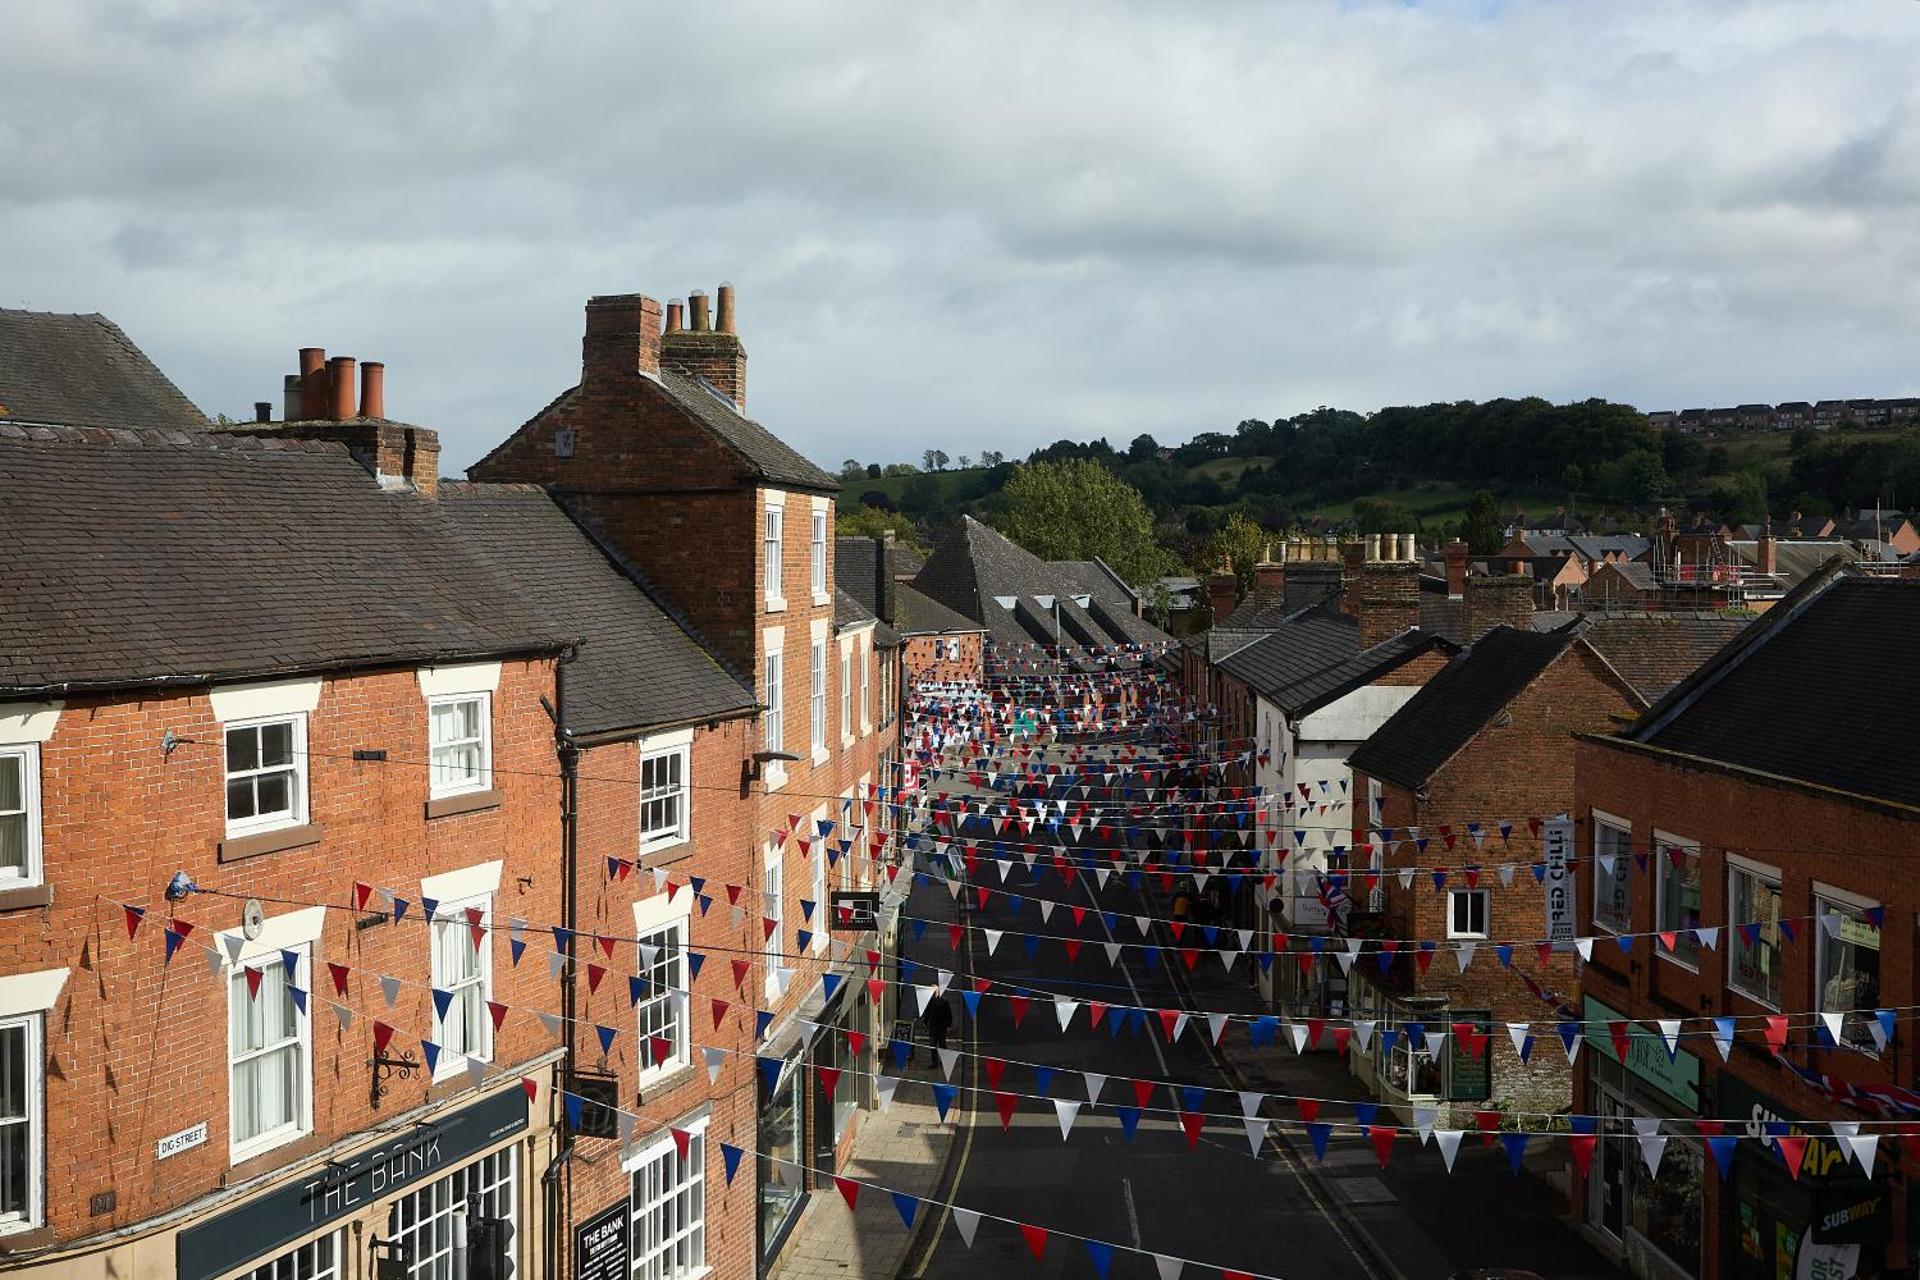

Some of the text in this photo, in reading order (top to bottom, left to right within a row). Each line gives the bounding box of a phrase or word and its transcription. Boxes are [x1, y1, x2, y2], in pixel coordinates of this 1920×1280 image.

[1550, 887, 1565, 920] RED
[162, 1128, 203, 1153] DIG STREET
[1745, 1103, 1843, 1176] SUAY
[304, 1133, 441, 1223] THE BANK
[583, 1228, 600, 1249] THE
[601, 1214, 624, 1238] BANK
[1820, 1196, 1882, 1232] SUBWAY
